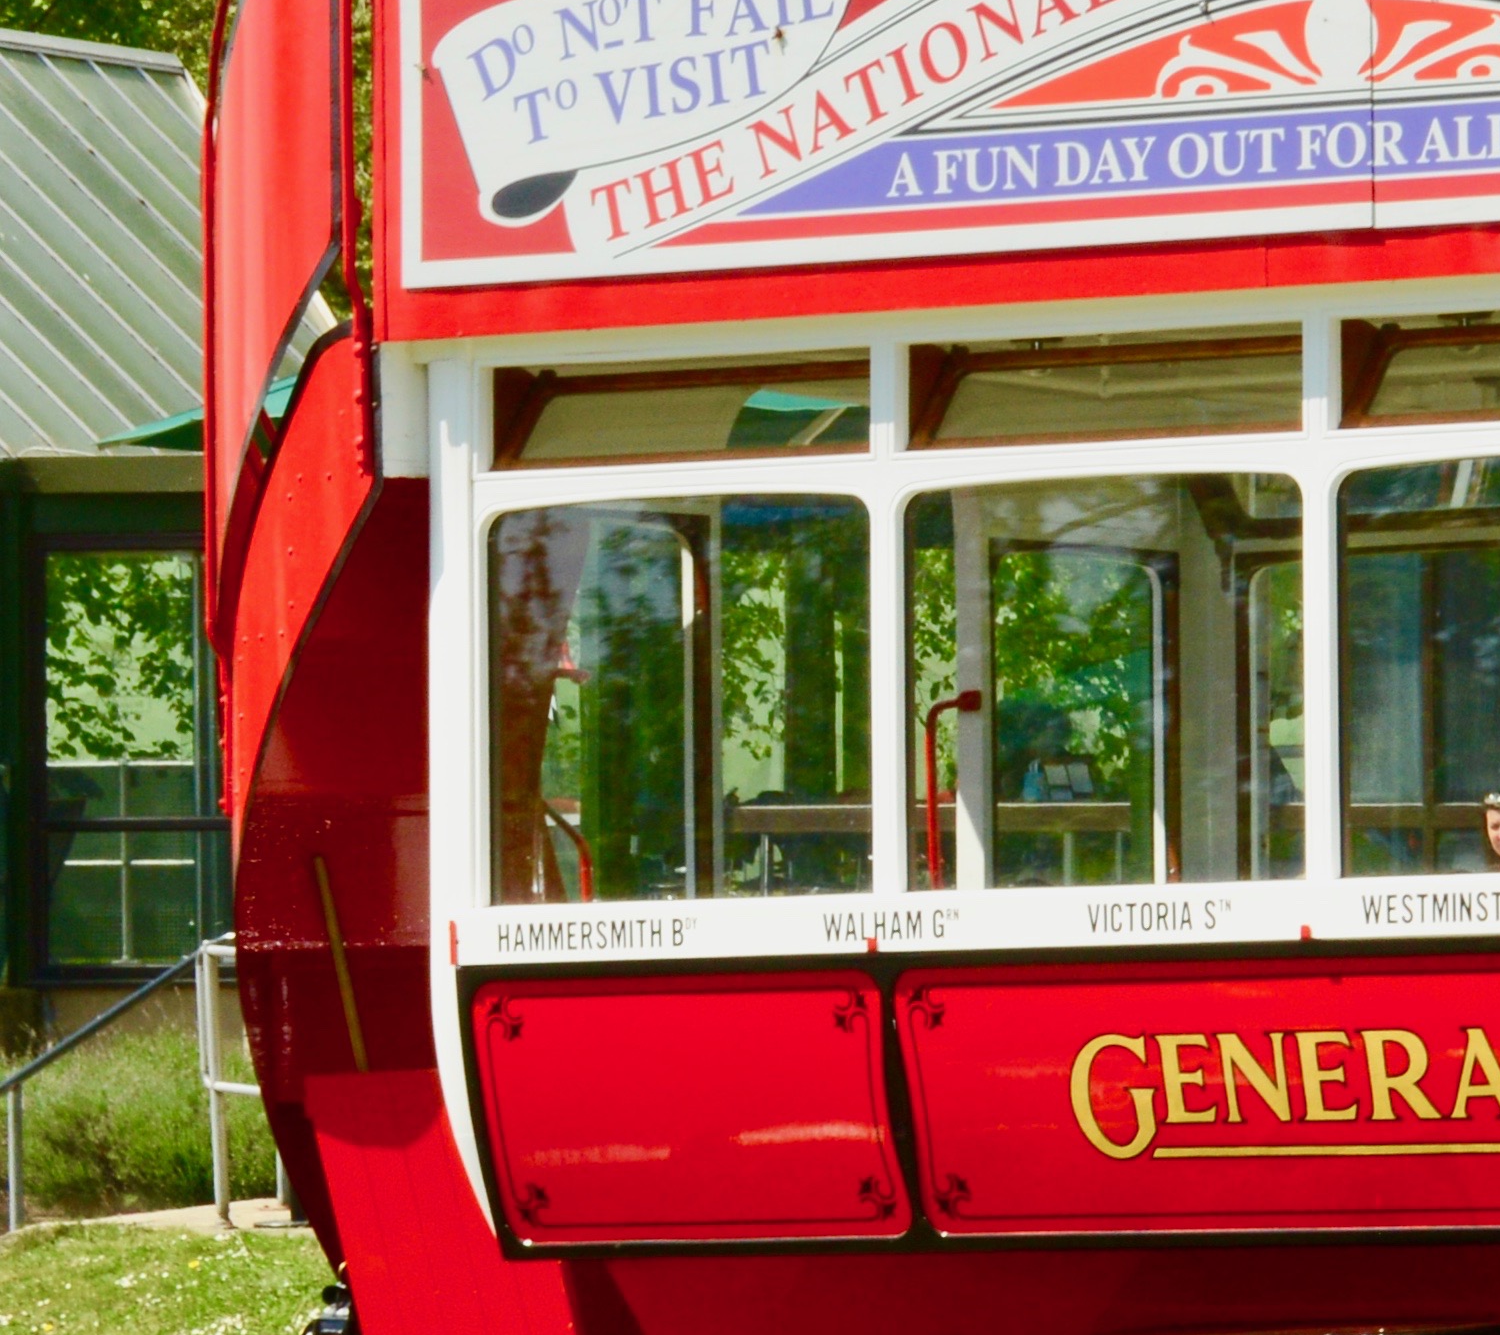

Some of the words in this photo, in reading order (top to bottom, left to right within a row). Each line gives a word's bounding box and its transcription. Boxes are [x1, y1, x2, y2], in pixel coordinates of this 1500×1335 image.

[594, 39, 770, 124] VISIT
[887, 153, 924, 198] A
[933, 144, 1041, 195] FUN
[1054, 136, 1155, 188] DAY
[1168, 128, 1284, 178] OUT
[1297, 120, 1407, 171] FOR
[591, 140, 735, 242] THE
[498, 918, 662, 953] HAMMERSMITH
[823, 910, 922, 942] WALHAM
[1087, 901, 1192, 933] VICTORIA
